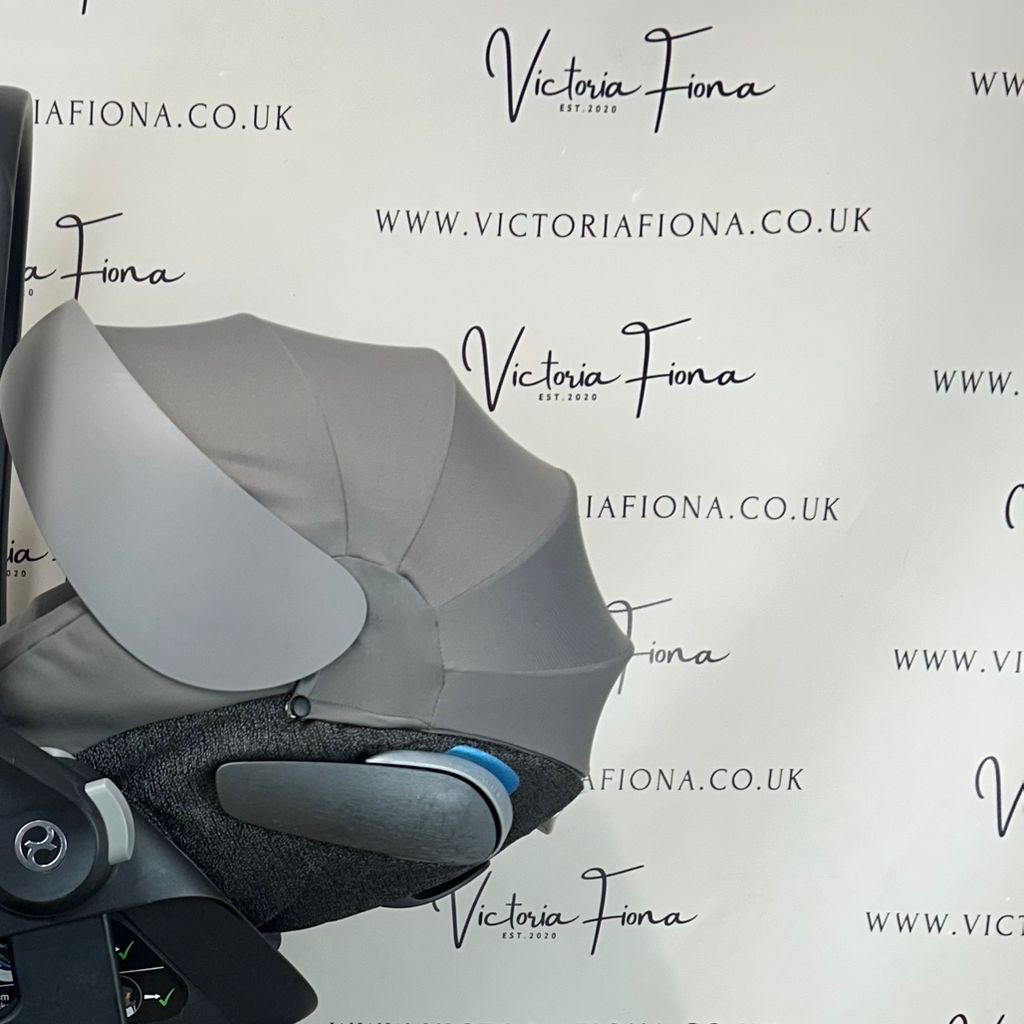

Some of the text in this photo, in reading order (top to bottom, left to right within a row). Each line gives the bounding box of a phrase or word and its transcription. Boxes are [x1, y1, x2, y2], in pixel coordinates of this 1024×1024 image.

[485, 26, 776, 133] Victoria Fiona
[559, 103, 617, 114] EST.2020
[376, 207, 872, 239] WWW.VICTORIAFIONA.CO.UK
[56, 212, 185, 300] Fiona
[462, 318, 756, 419] Victoria Fiona
[538, 392, 598, 402] EST.2020
[432, 865, 698, 955] Victoria Fiona
[502, 931, 557, 940] EST.2020
